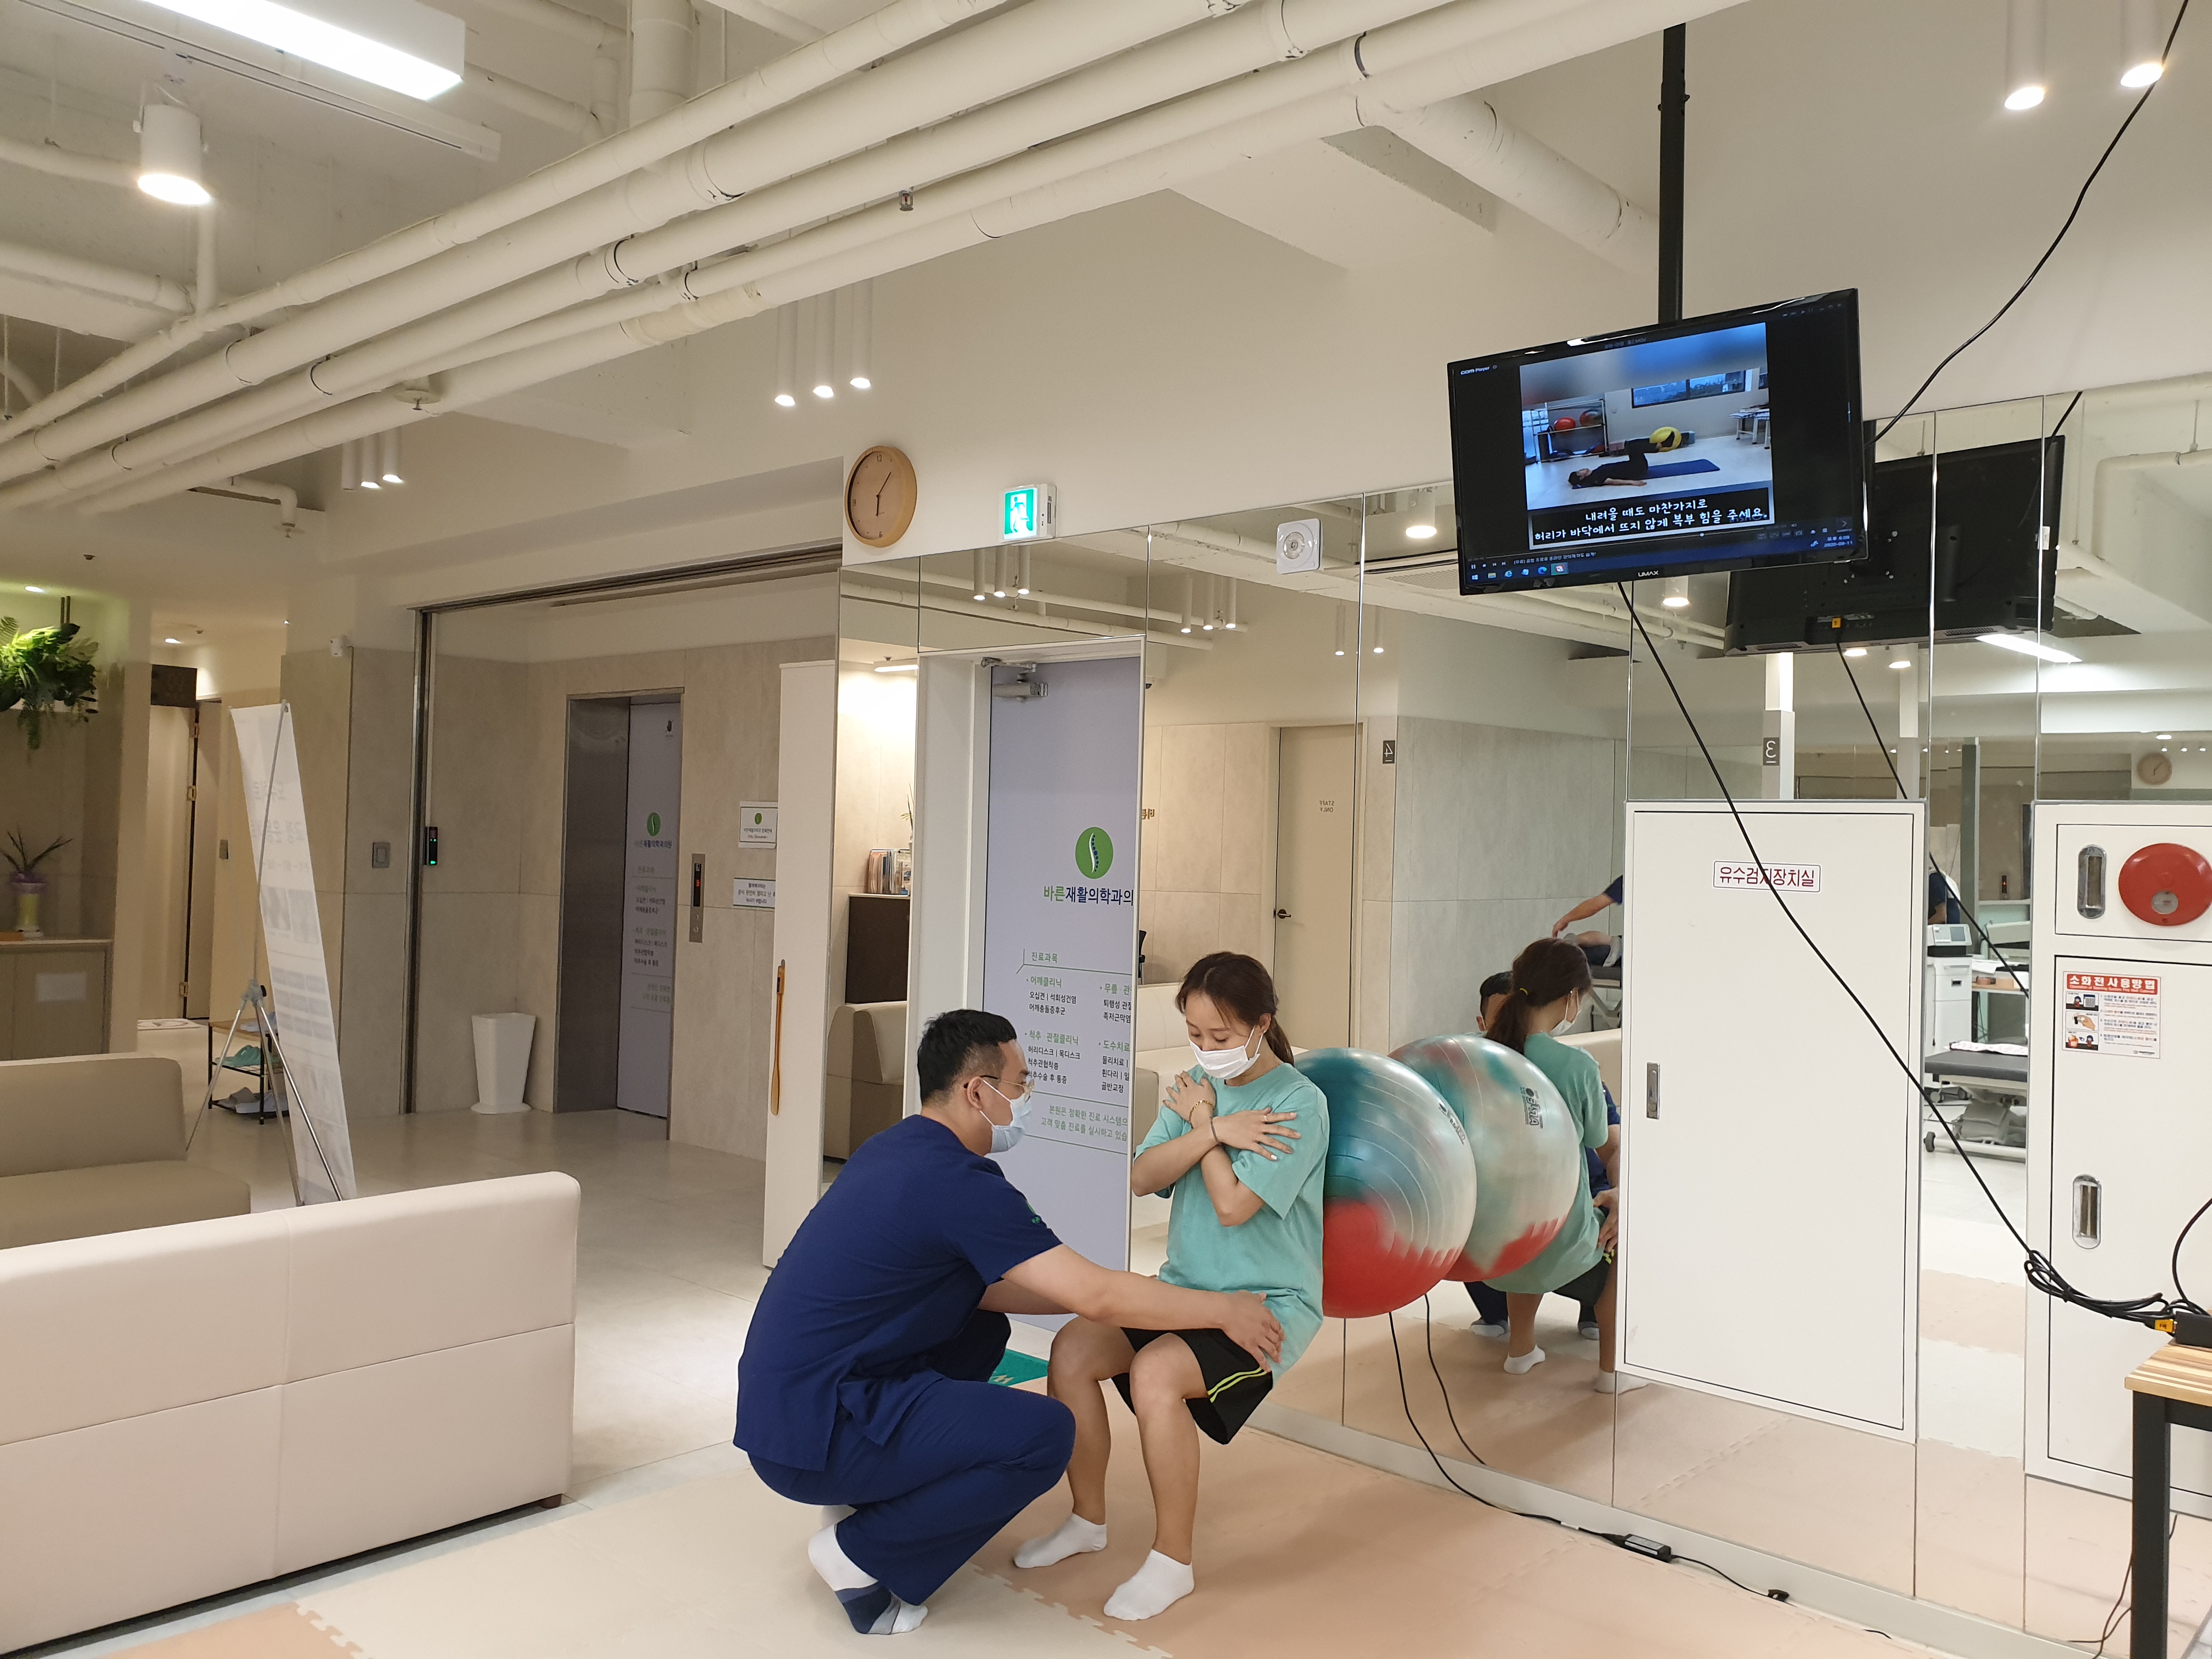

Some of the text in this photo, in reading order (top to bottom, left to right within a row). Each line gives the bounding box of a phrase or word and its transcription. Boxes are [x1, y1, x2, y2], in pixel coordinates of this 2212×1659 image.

[1585, 498, 1708, 522] 내려올 때도 마찬가지로
[1534, 529, 1566, 541] 허리가
[1570, 523, 1615, 538] 바닥에서
[1619, 520, 1640, 533] 뜨지
[1645, 517, 1668, 531] 않게
[1672, 514, 1695, 527] 복부
[1700, 509, 1723, 525] 힘을
[1726, 507, 1767, 521] 주세요.
[1719, 867, 1814, 887] 유수검지장치실
[1043, 885, 1134, 906] 바른재활의학과의
[1031, 952, 1058, 963] 진료과목
[1030, 976, 1062, 988] 어깨클리닉
[1123, 985, 1132, 995] 관
[1029, 991, 1076, 1004] 오십견 석회성건염
[1029, 1003, 1065, 1015] 어깨충돌증후군
[1104, 999, 1120, 1009] 퇴행성
[1103, 1012, 1131, 1023] 족저근막염
[1029, 1030, 1079, 1046] 척추 관절클리닉
[1028, 1045, 1080, 1059] 허리디스크 목디스크
[1103, 1040, 1130, 1052] 도수치료
[1028, 1058, 1059, 1070] 척추관협착증
[1102, 1056, 1124, 1066] 물리치료
[1057, 1075, 1067, 1084] 통증
[1102, 1069, 1119, 1079] 휜다리
[1101, 1082, 1124, 1093] 골반교정
[1049, 1105, 1067, 1116] 본원은
[1089, 1112, 1101, 1121] 진료
[1041, 1118, 1053, 1128] 고객
[1088, 1126, 1113, 1137] 실시하고
